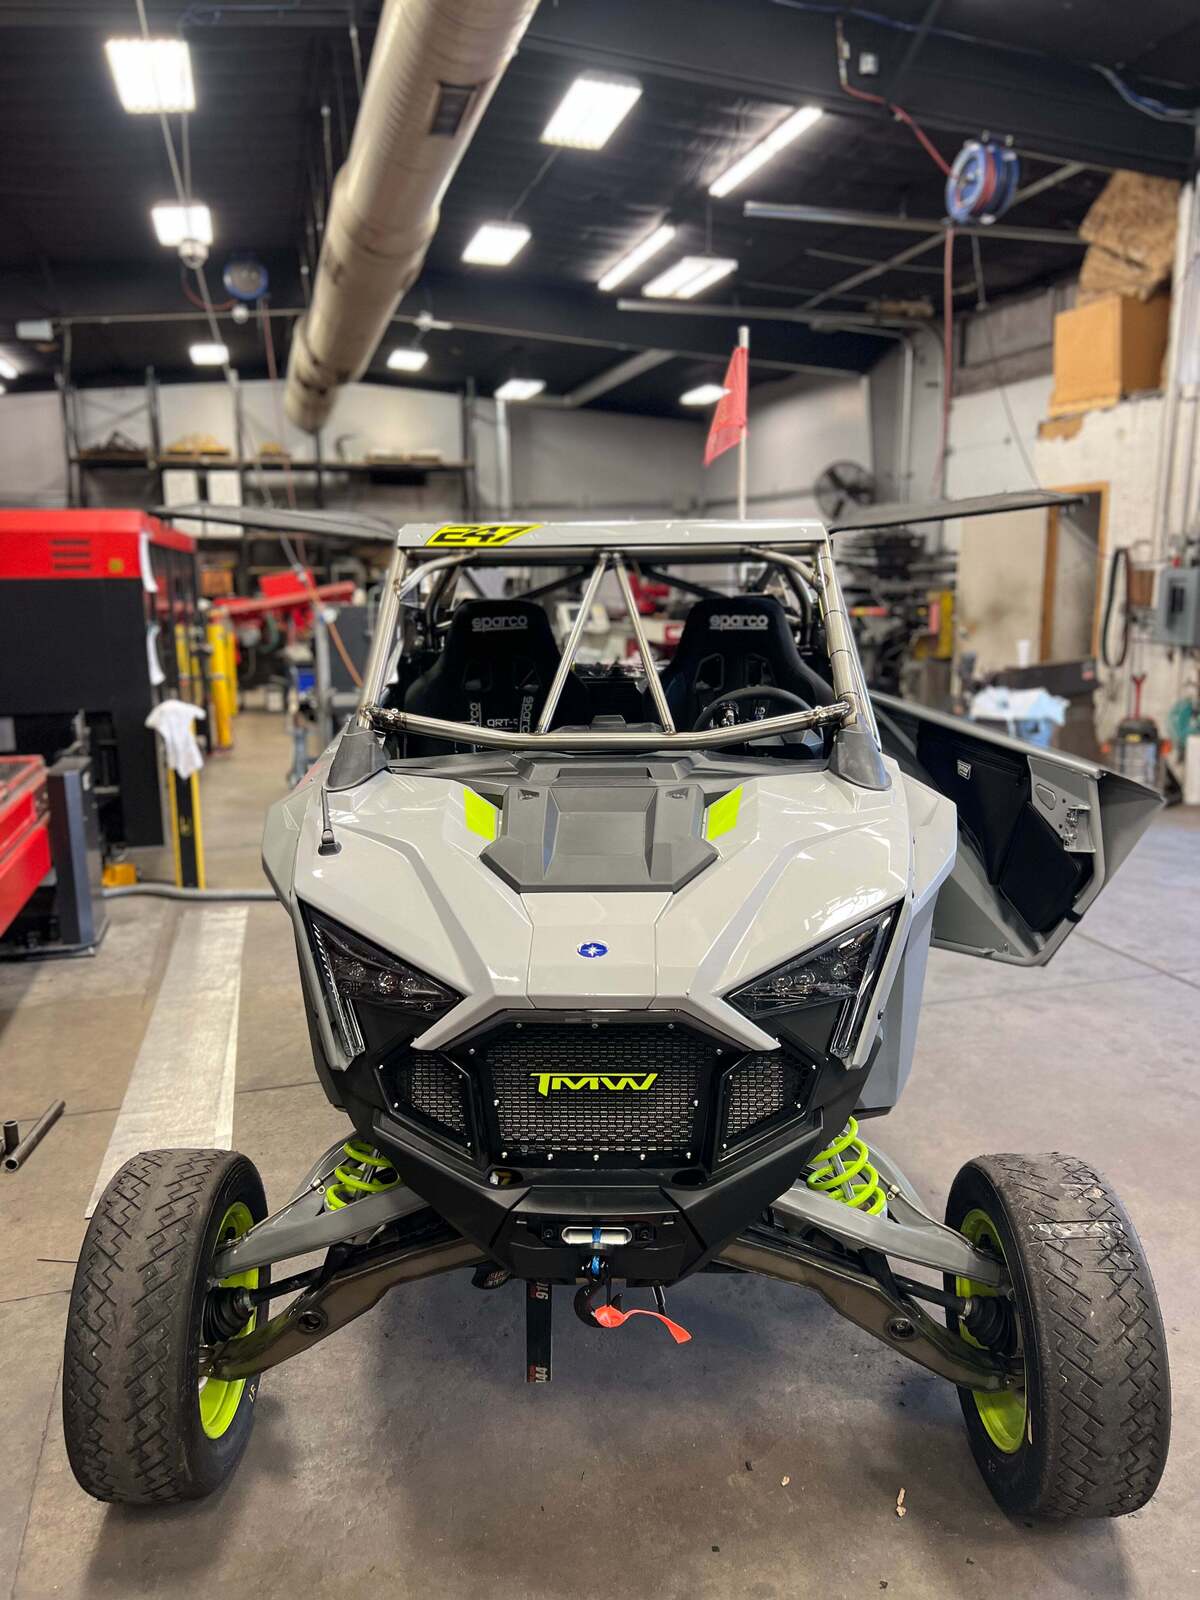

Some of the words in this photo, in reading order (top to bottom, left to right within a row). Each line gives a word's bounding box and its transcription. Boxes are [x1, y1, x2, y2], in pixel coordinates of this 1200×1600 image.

[432, 526, 534, 543] 247
[471, 614, 529, 632] sparco
[709, 613, 768, 632] sparco
[520, 695, 534, 733] sparc
[529, 1073, 658, 1096] TMW
